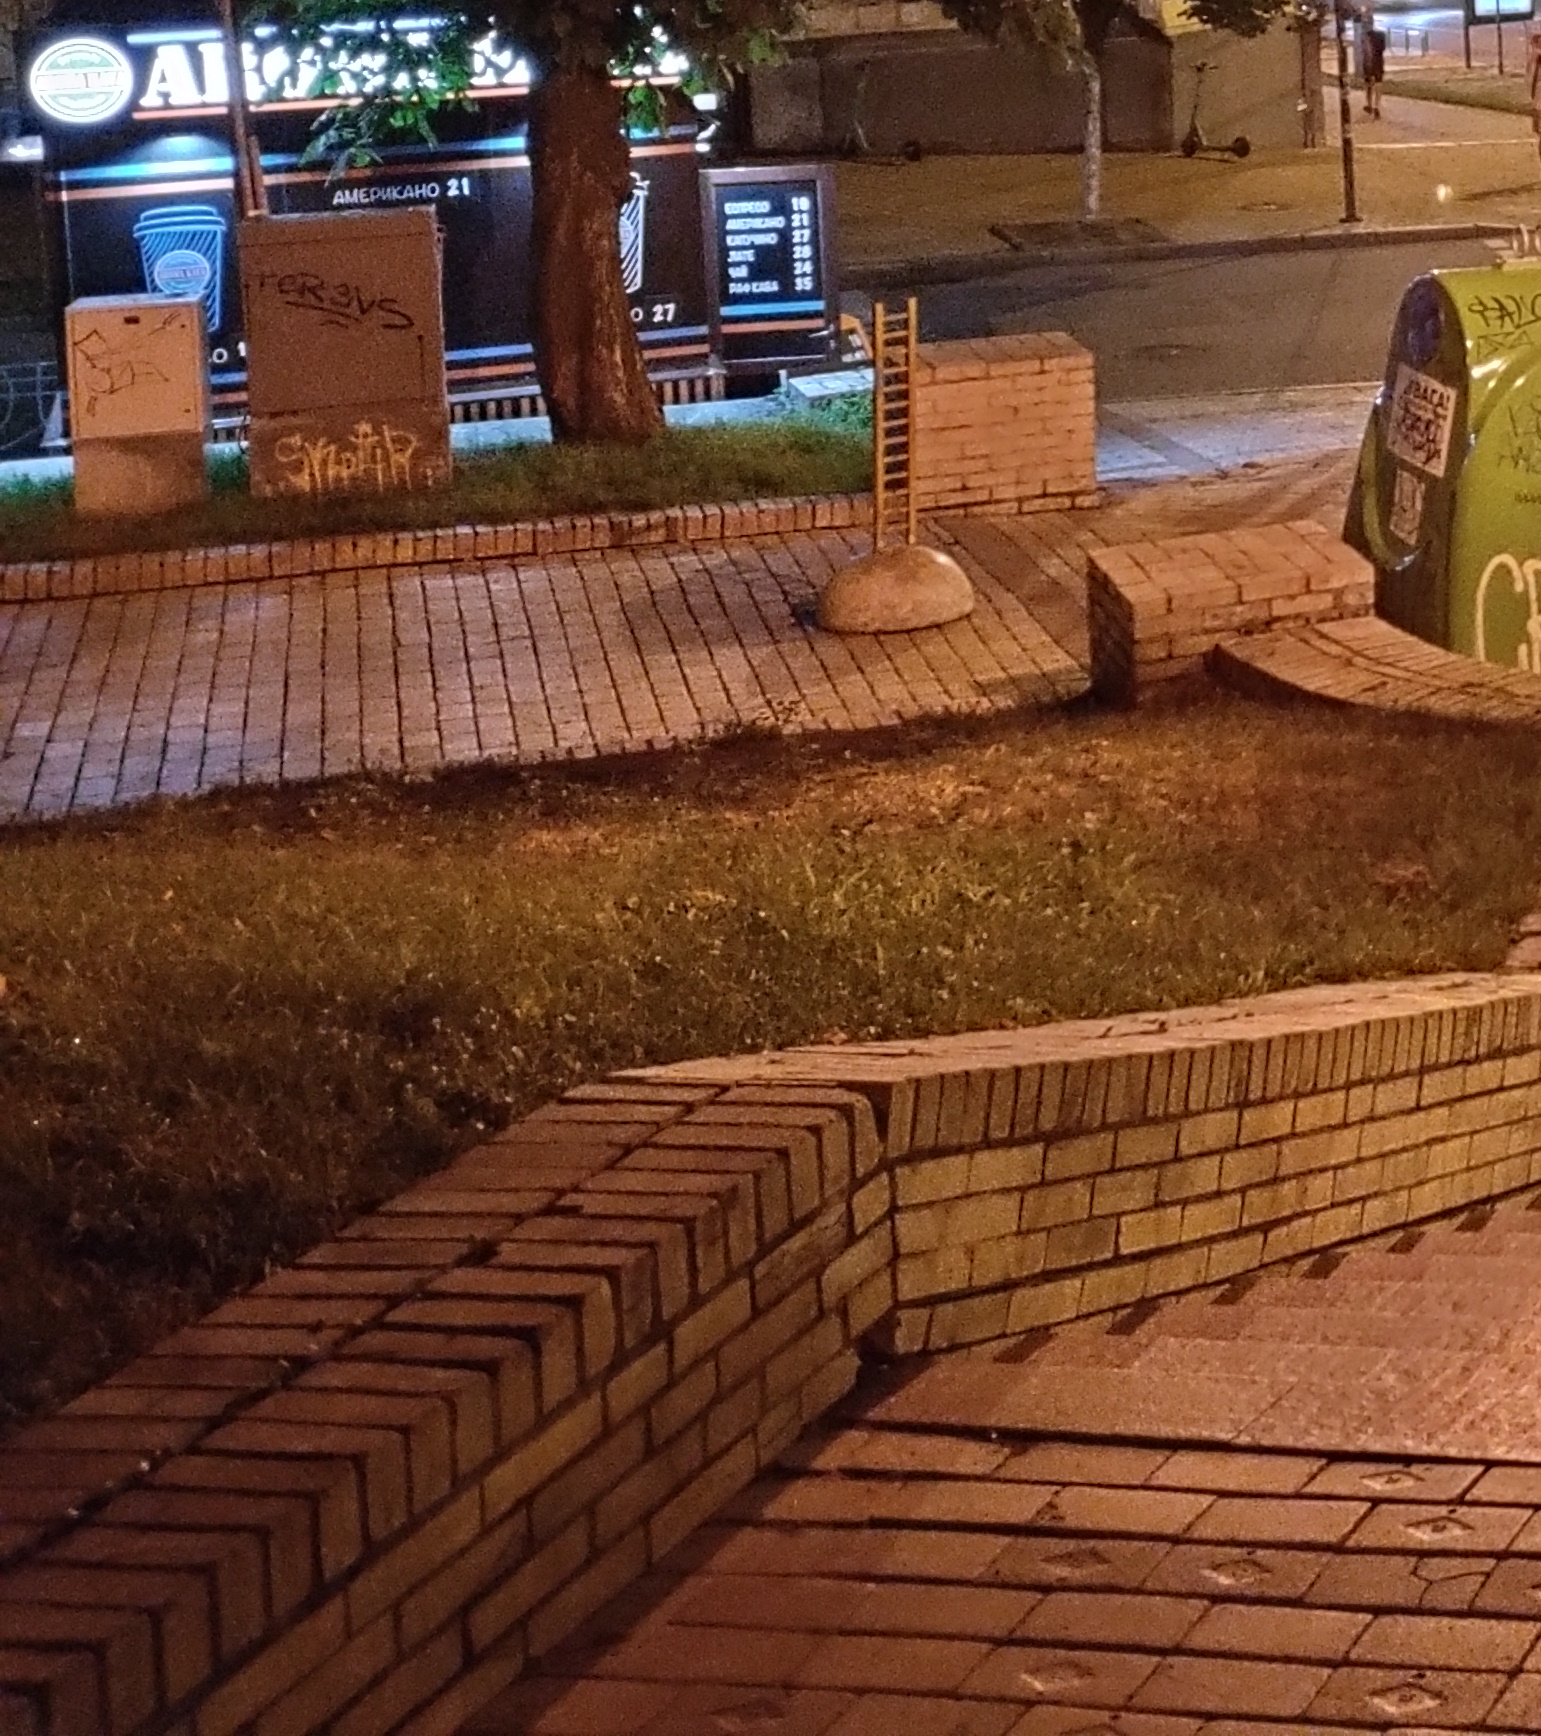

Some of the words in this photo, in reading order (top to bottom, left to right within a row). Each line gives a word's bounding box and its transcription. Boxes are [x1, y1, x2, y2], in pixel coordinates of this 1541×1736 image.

[332, 183, 440, 206] АМЕРИКАНО
[446, 177, 471, 196] 21
[791, 213, 810, 227] 21
[792, 229, 811, 243] 27
[794, 261, 814, 275] 24
[652, 302, 676, 323] 27
